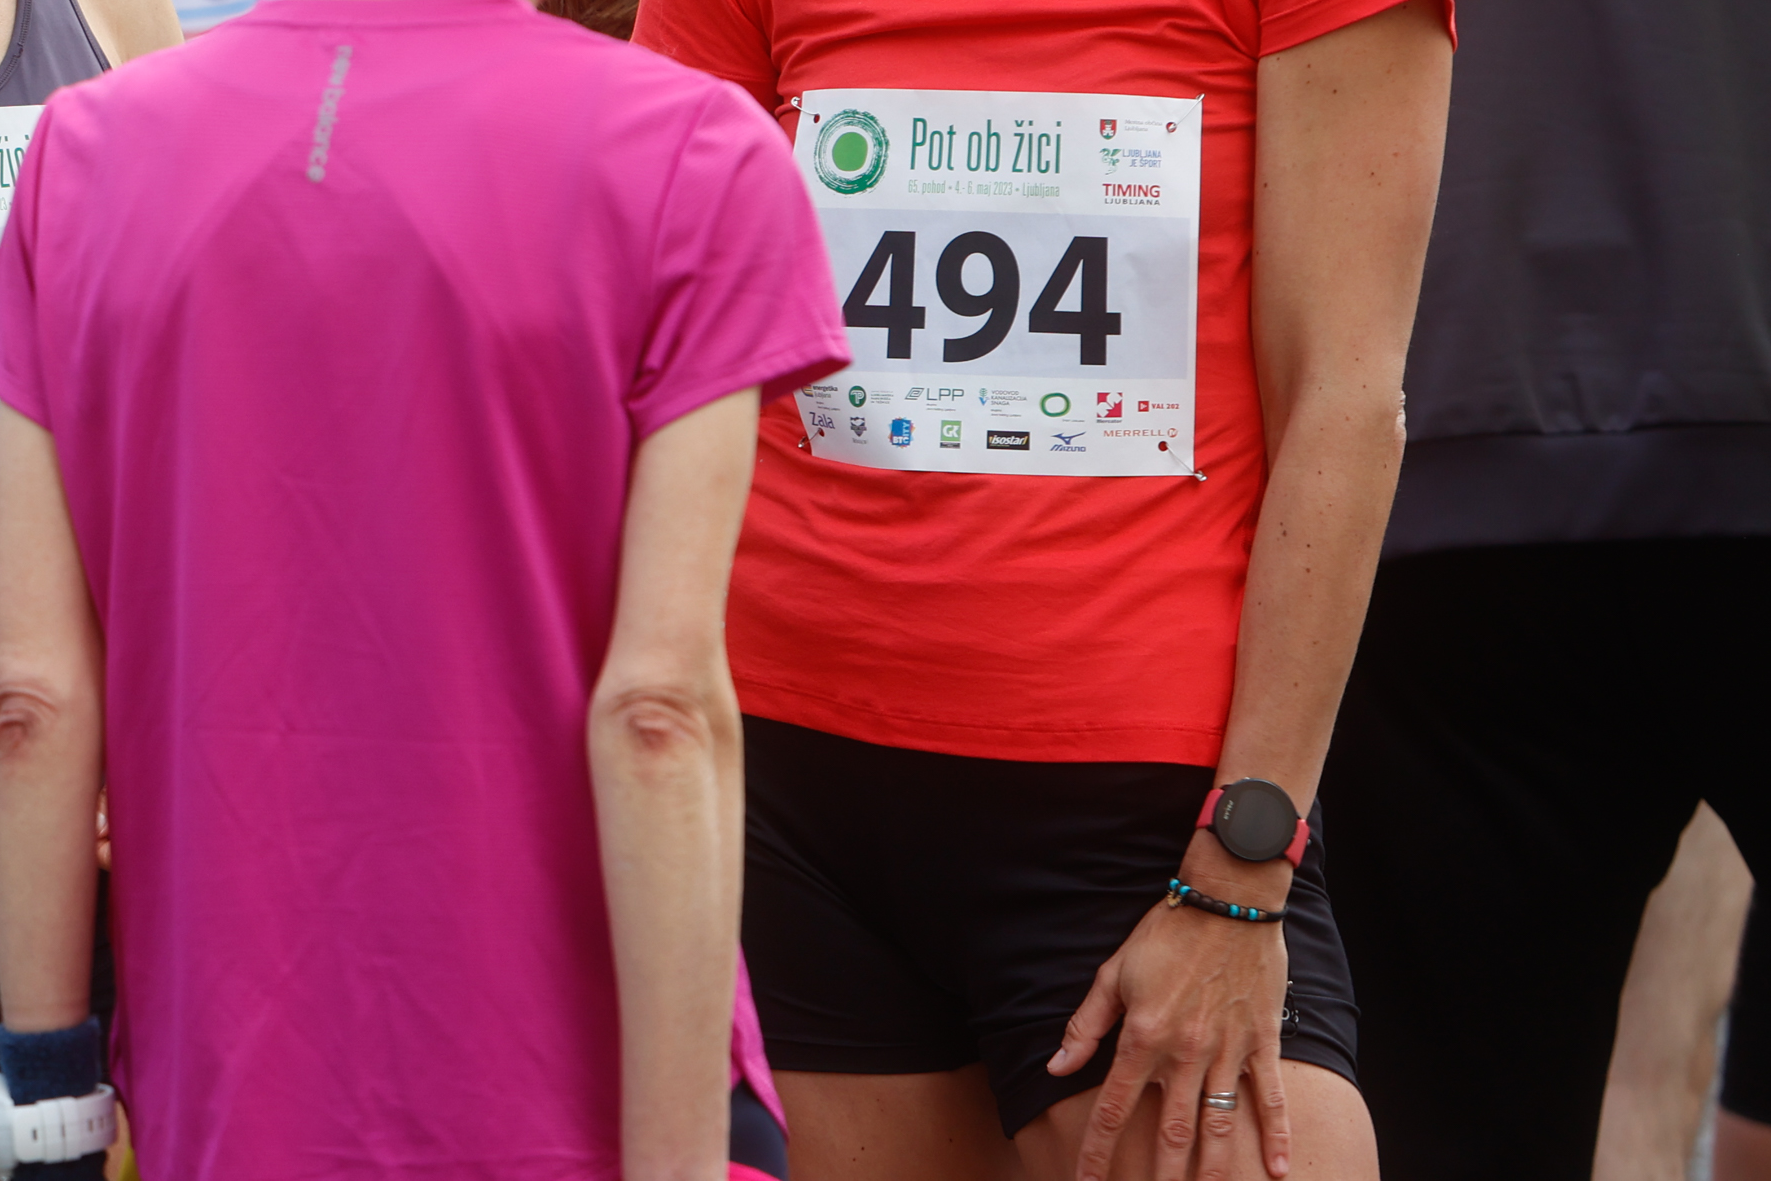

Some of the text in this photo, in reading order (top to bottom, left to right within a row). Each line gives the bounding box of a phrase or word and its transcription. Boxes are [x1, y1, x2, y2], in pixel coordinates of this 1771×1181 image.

[910, 117, 1062, 174] Pot ob žici
[1122, 149, 1162, 158] LJUBLJANA
[1129, 157, 1162, 168] JE ŠPORT
[908, 180, 920, 194] 65.
[922, 180, 946, 195] pohod
[977, 182, 991, 196] maj
[993, 181, 1013, 196] 2023
[1023, 182, 1060, 198] Ljubljana
[1102, 183, 1161, 198] TIMING
[1104, 198, 1161, 206] LJUBLJANA
[841, 230, 1122, 365] 494
[926, 388, 965, 401] LPP
[809, 411, 835, 429] Zala
[1103, 429, 1165, 437] MERRELL
[892, 436, 910, 444] BTC
[991, 435, 1025, 446] isostar
